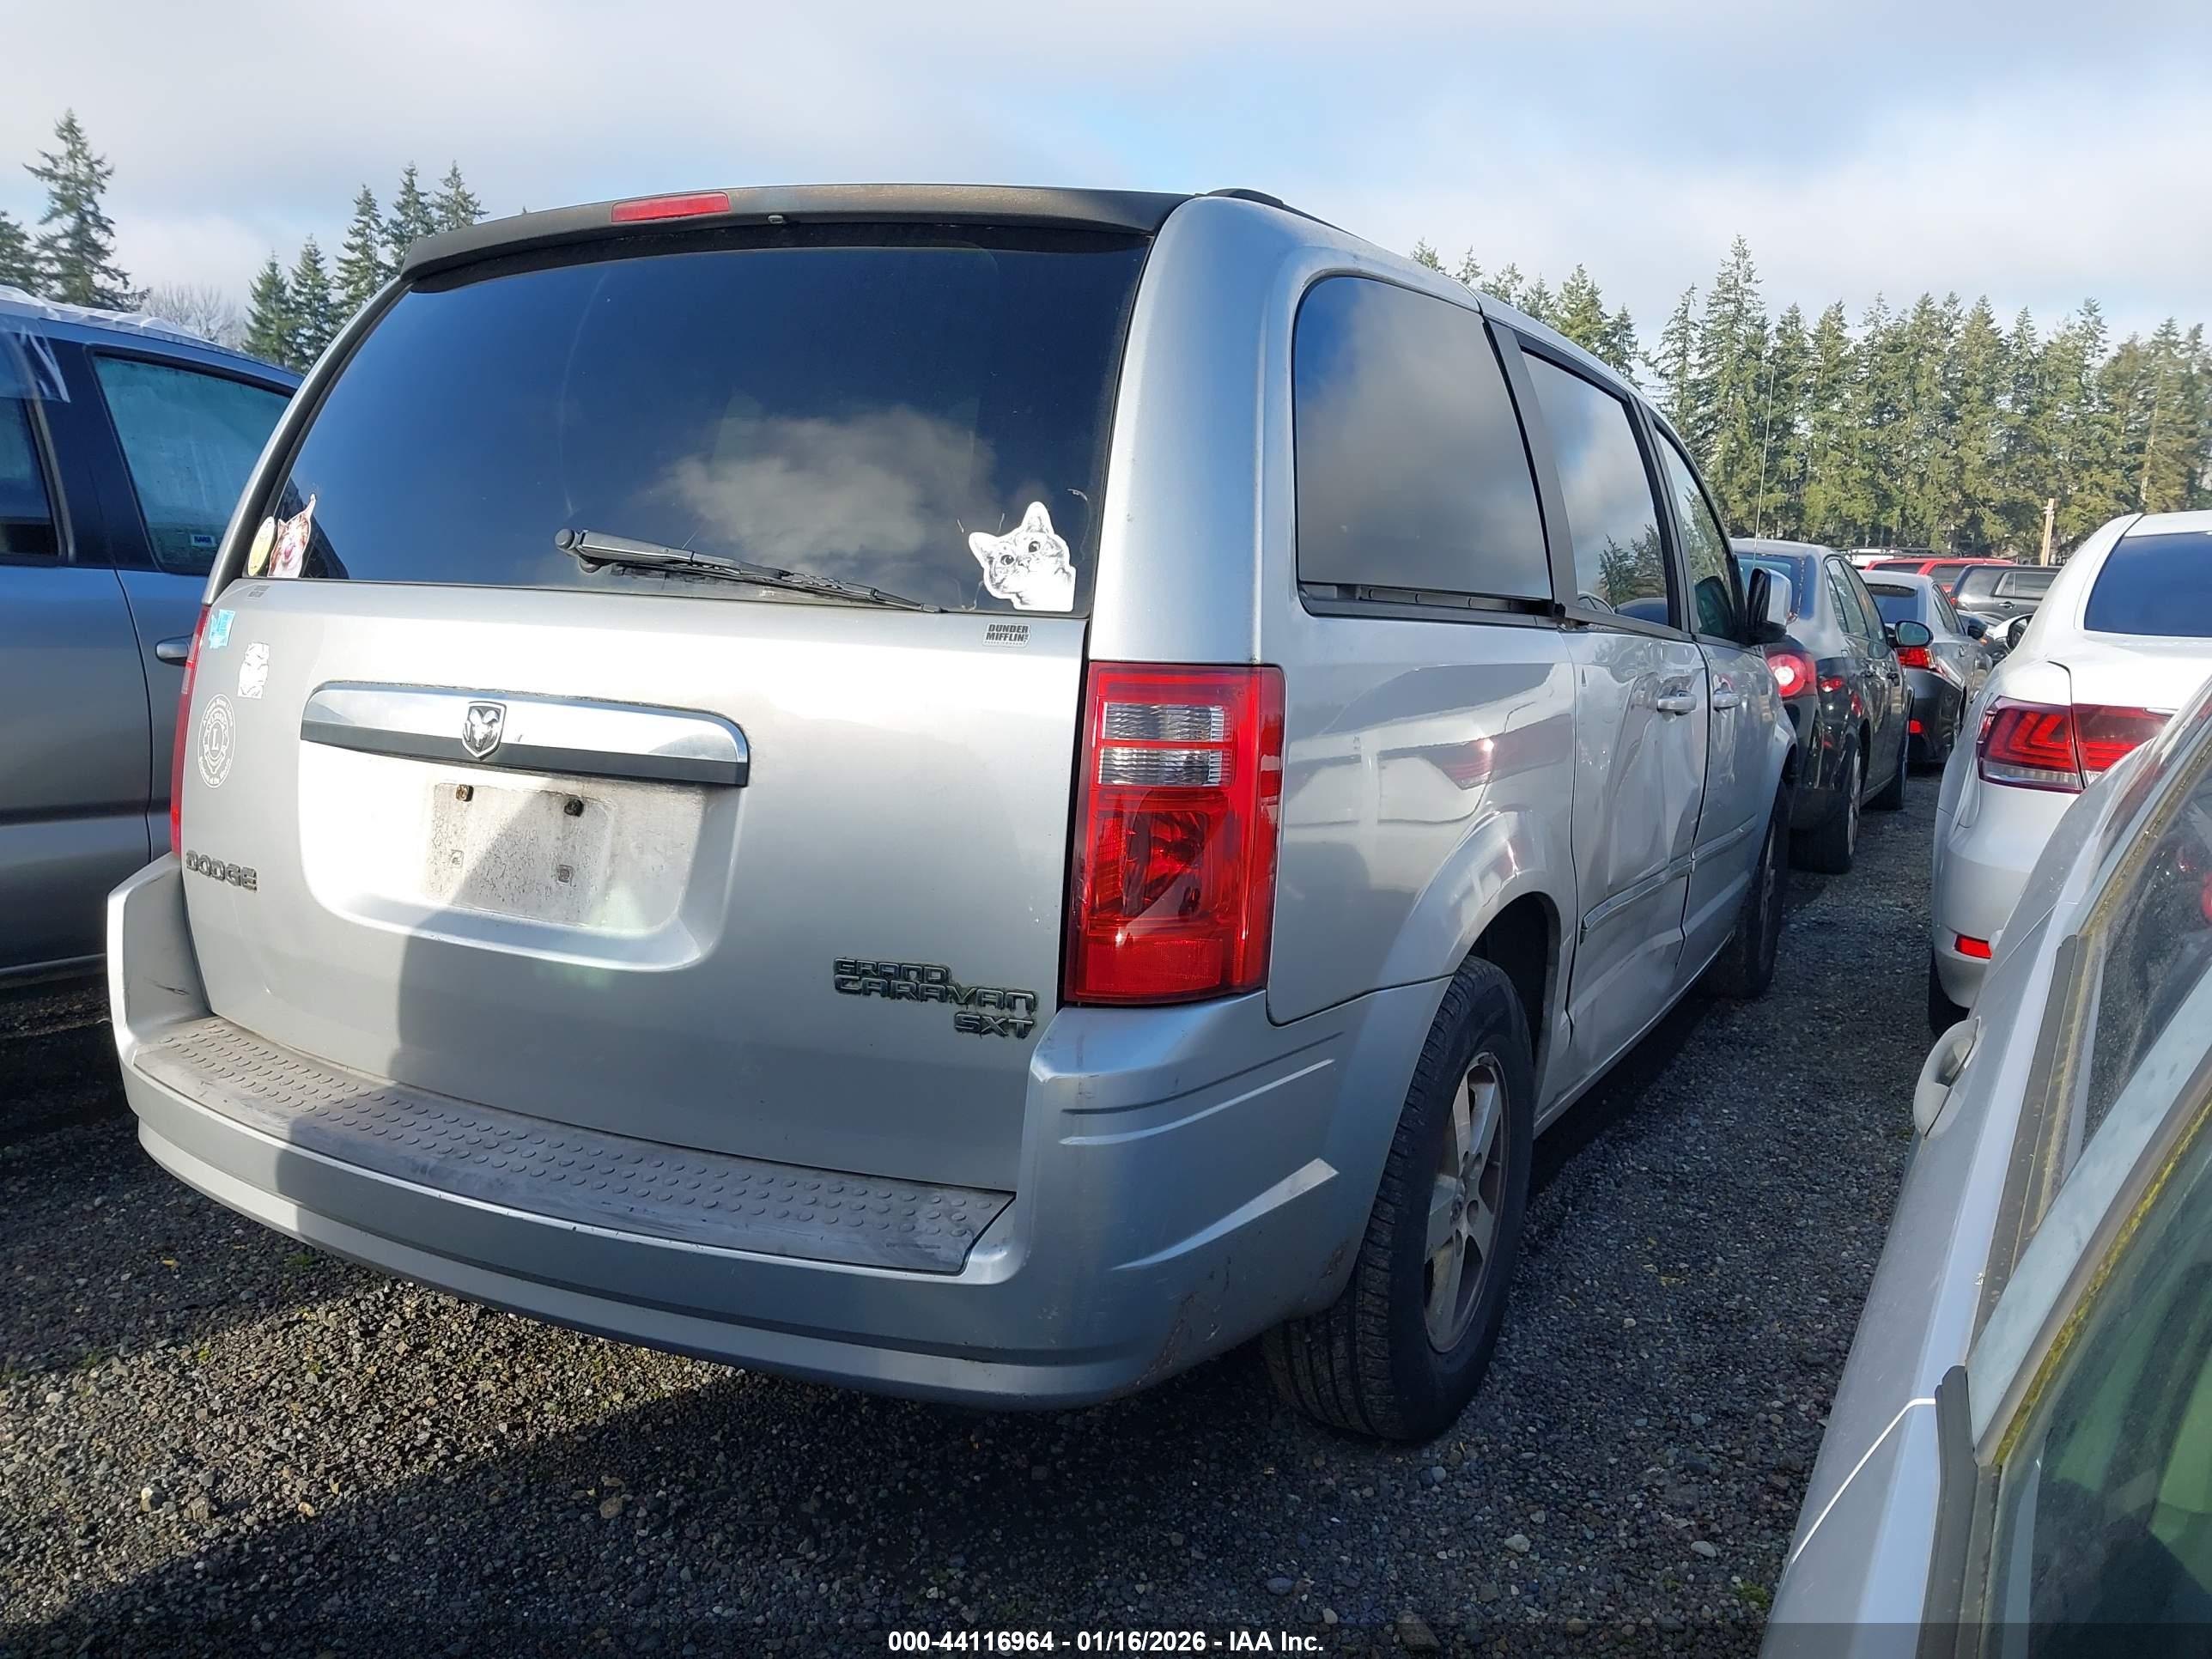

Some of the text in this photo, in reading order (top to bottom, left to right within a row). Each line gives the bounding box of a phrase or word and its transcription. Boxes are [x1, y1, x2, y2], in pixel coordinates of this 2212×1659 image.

[988, 624, 1029, 633] DUNDER
[185, 850, 258, 891] DODGE
[833, 957, 951, 984] GRAND
[834, 974, 1036, 1014] CARAVAN
[954, 1012, 1034, 1037] SXT
